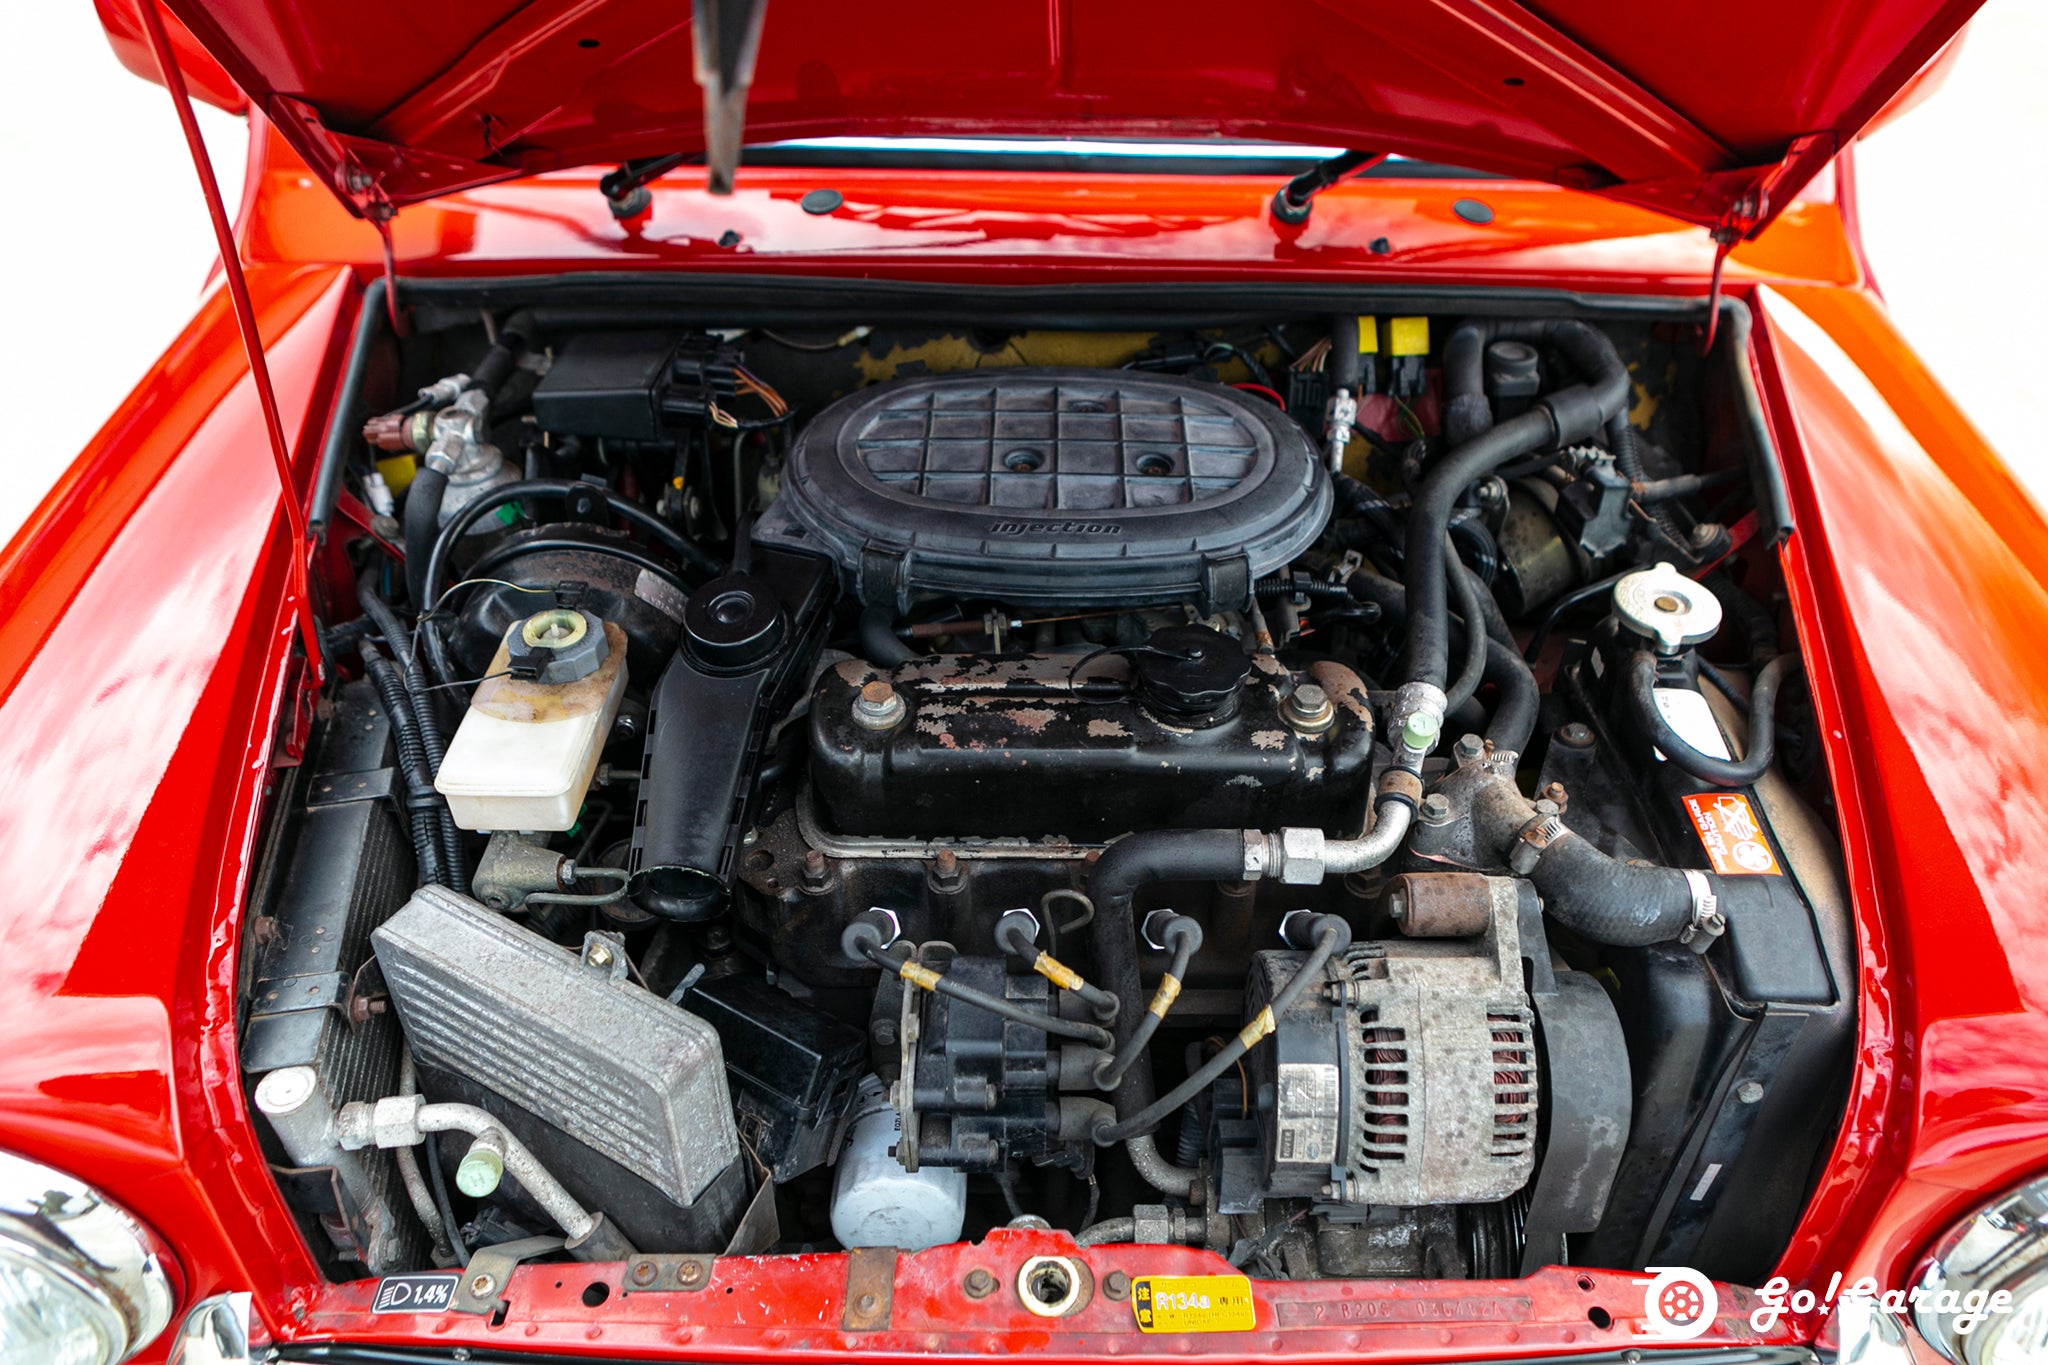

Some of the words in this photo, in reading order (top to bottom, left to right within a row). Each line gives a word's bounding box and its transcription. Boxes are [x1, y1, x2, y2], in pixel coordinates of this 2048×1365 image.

[991, 521, 1121, 537] injection
[1703, 812, 1728, 855] CAUTION
[413, 1284, 450, 1305] 1,4%
[1155, 1292, 1211, 1310] R134a
[1314, 1303, 1324, 1320] 2
